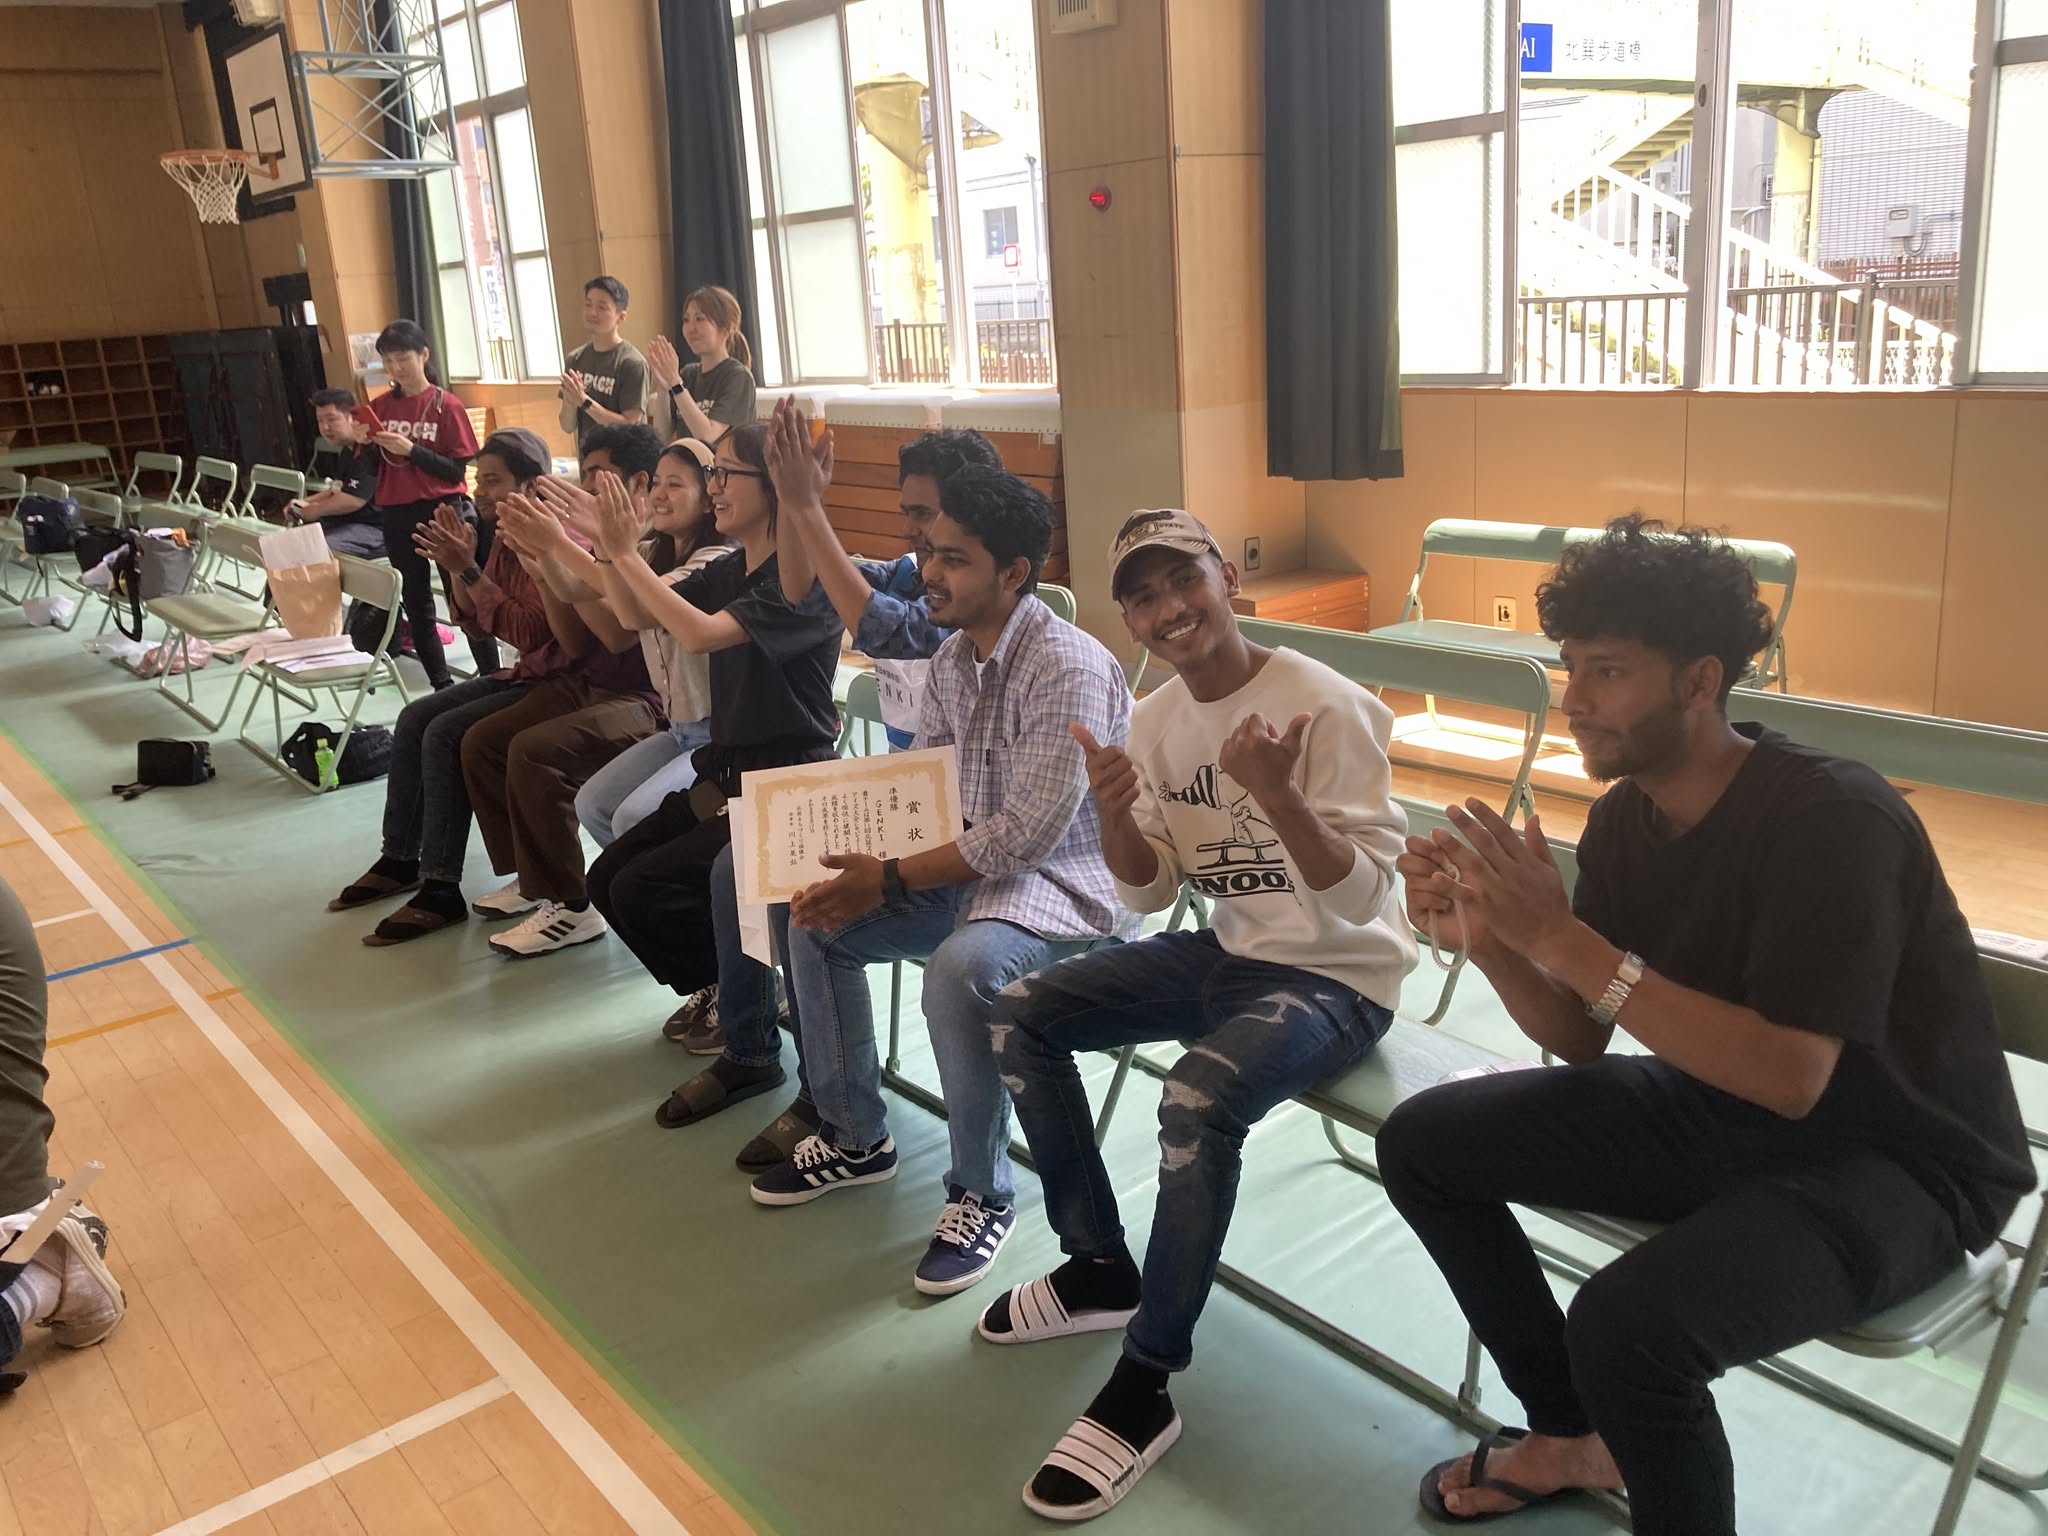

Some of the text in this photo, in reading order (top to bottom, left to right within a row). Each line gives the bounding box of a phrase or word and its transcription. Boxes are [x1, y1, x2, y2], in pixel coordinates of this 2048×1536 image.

[1565, 38, 1641, 62] 北巽歩道橋
[889, 787, 900, 811] 準優勝
[875, 799, 885, 842] GENKI
[906, 800, 924, 842] 賞状
